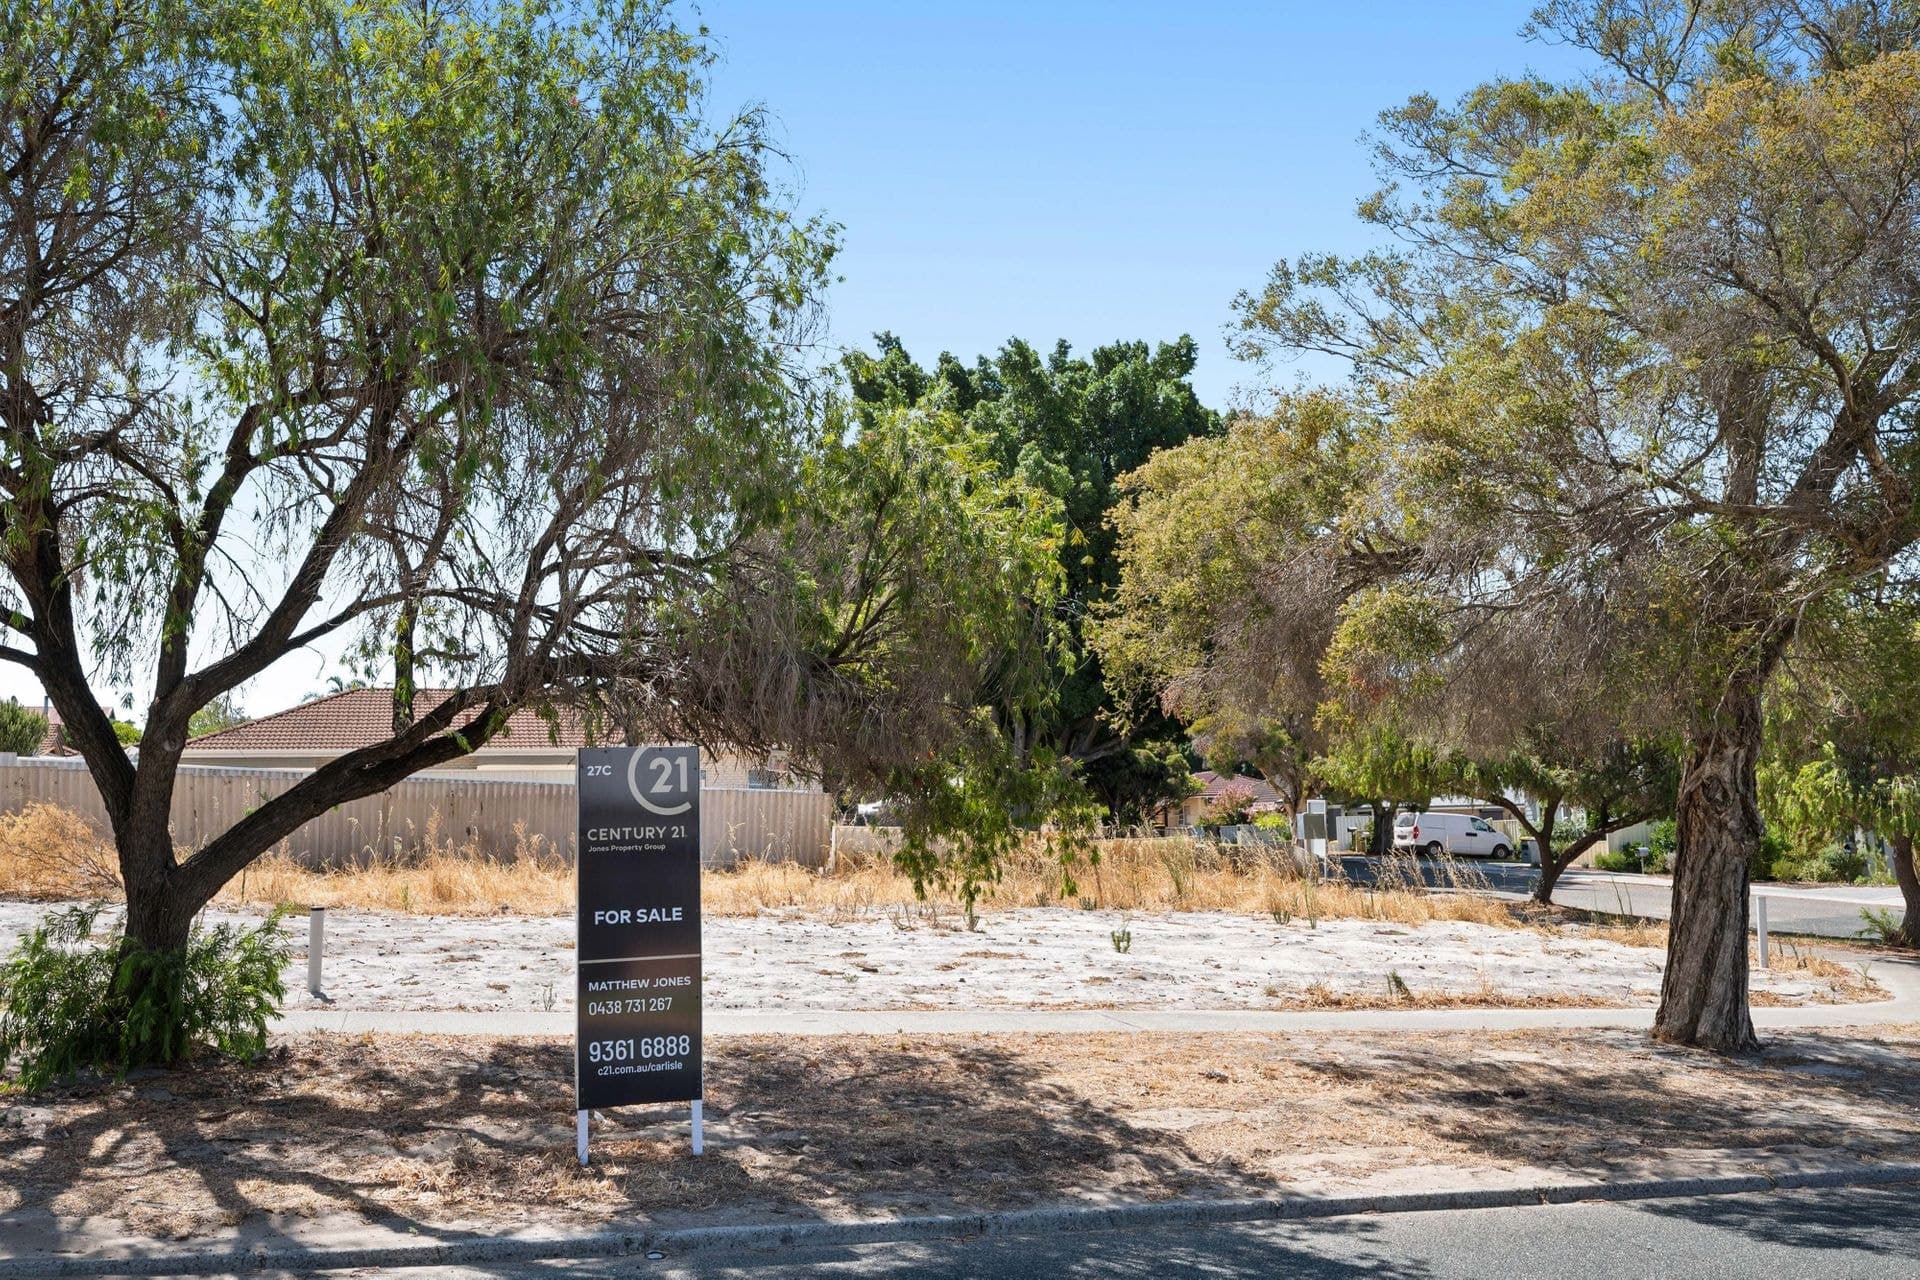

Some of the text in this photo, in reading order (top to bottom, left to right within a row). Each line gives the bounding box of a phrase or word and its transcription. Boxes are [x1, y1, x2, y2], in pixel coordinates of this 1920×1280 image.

[587, 765, 612, 776] 27C
[587, 825, 685, 841] CENTURY 21
[611, 844, 642, 852] Property
[644, 843, 666, 851] Group
[594, 907, 683, 925] FOR SALE
[588, 976, 691, 991] MATTHEW JONES
[588, 997, 672, 1016] 0438 731 267
[589, 1035, 690, 1062] 9361 6888
[597, 1060, 683, 1076] c21.com.au/carlisle
